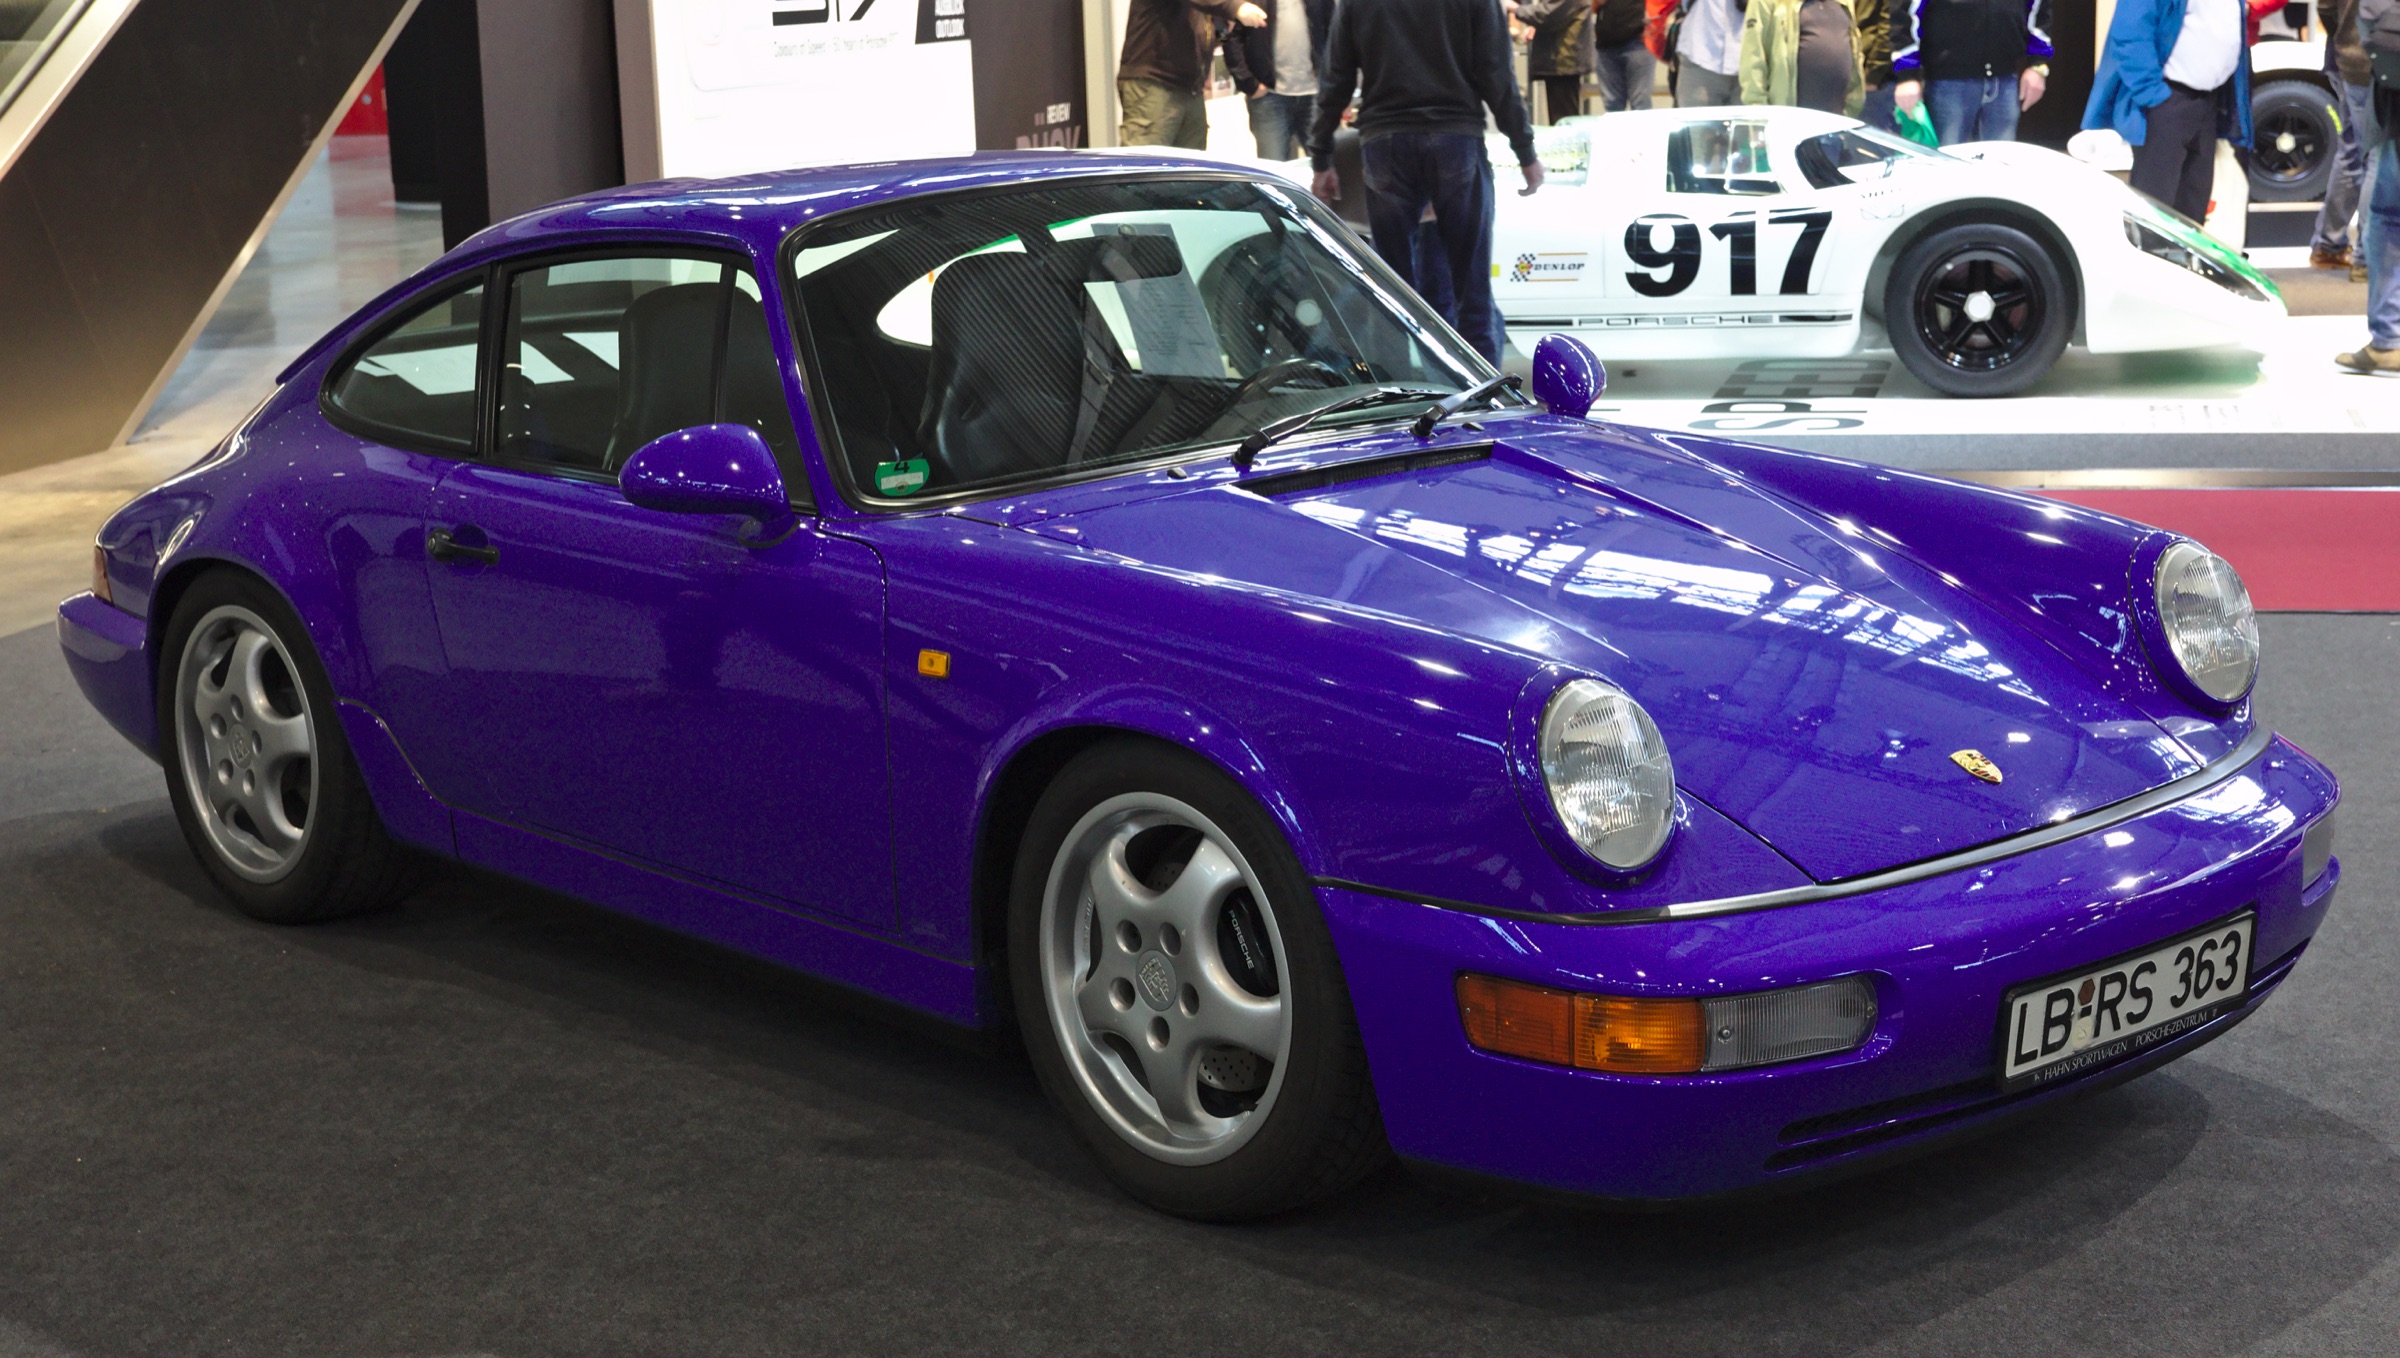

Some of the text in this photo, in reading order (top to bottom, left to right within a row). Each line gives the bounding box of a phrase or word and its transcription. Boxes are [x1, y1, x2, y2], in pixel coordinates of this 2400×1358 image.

[1534, 263, 1585, 271] DUNLOP
[1624, 208, 1833, 298] 917
[1579, 314, 1774, 327] PORSCHE
[894, 461, 910, 473] 4
[1228, 908, 1255, 970] PORSCHE
[2170, 930, 2242, 1008] 363
[2044, 1011, 2207, 1080] HAHN SPORTWAGEN PORSCHE-ZENTRUM
